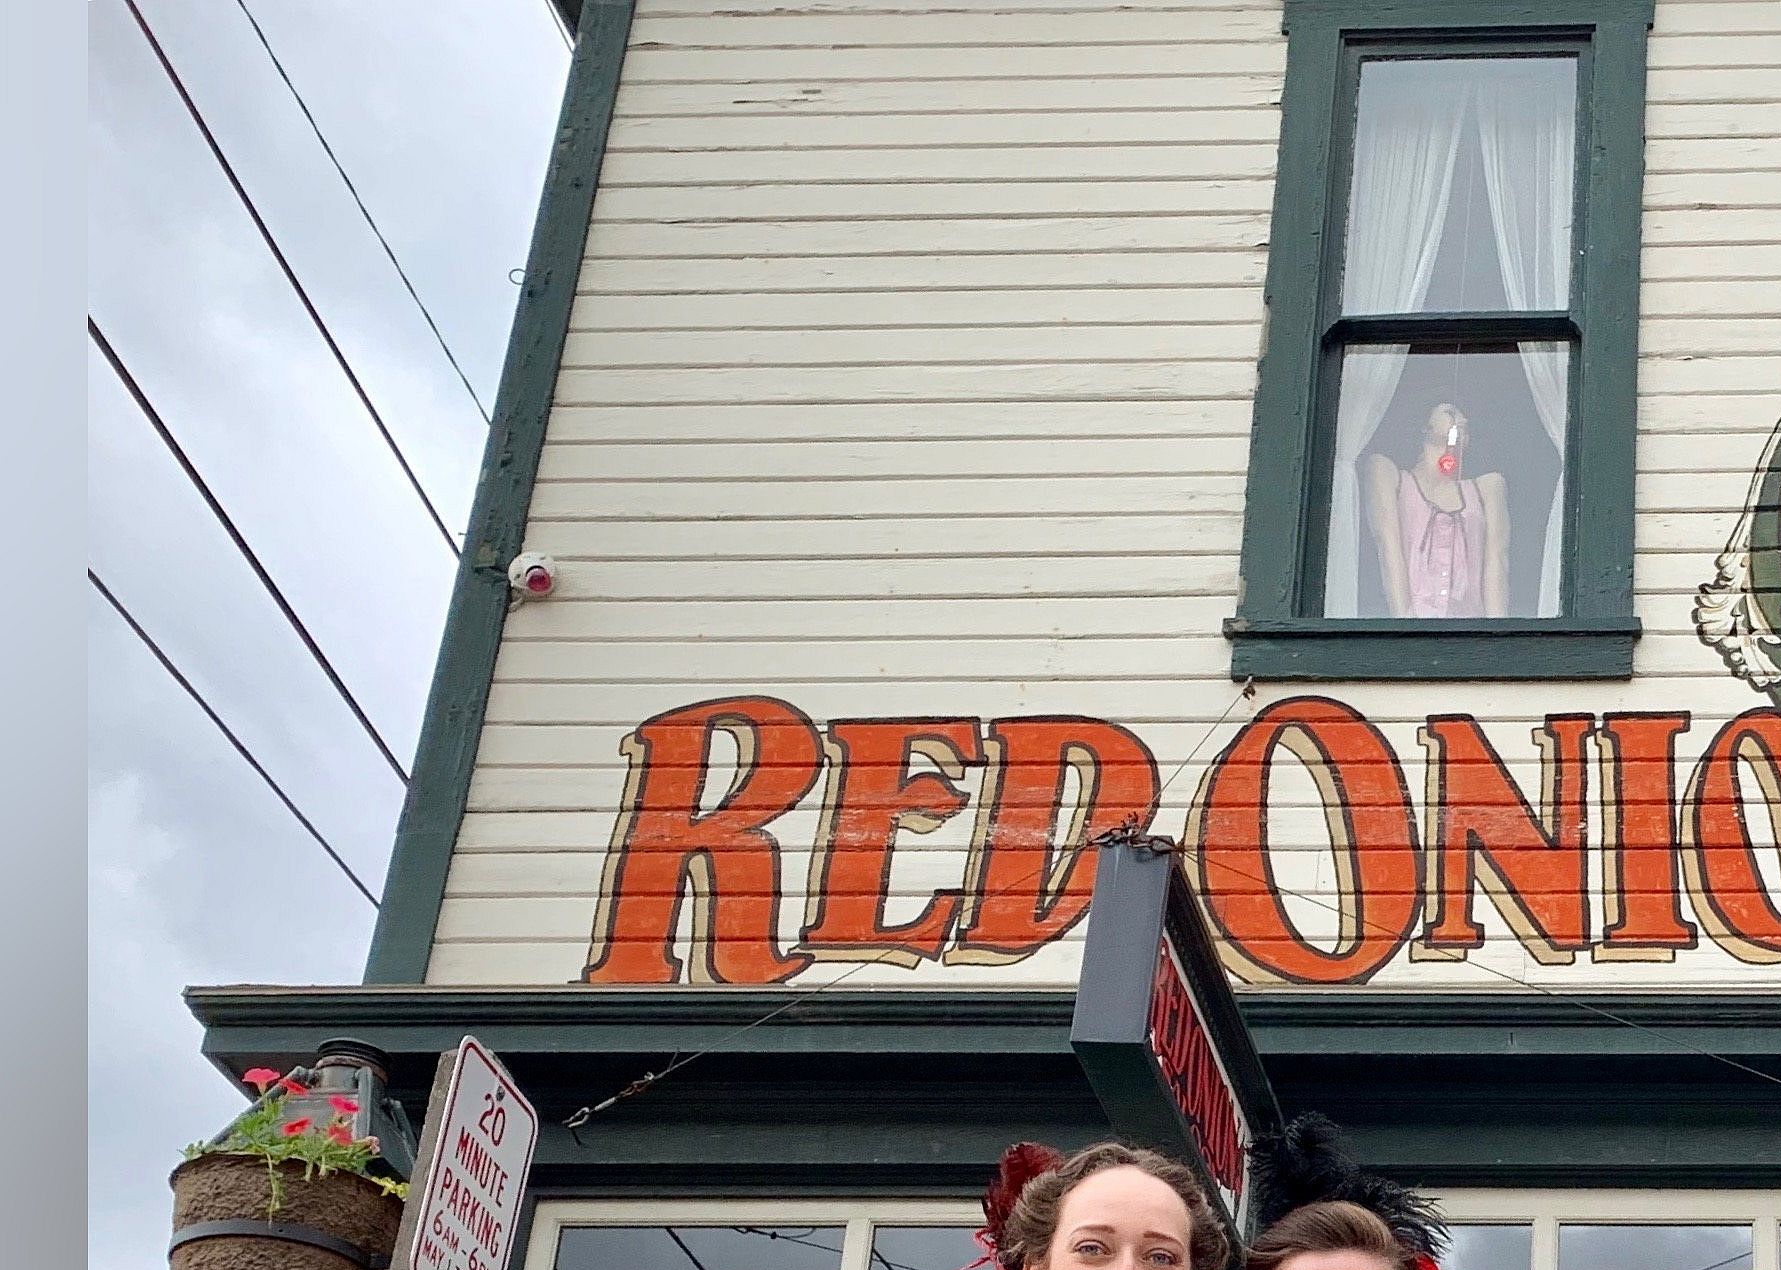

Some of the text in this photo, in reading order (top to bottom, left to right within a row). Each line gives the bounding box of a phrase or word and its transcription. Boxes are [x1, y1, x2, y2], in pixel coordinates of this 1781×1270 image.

[582, 695, 1161, 985] RED
[478, 1092, 507, 1147] 20
[455, 1126, 509, 1208] MINUTE
[422, 1235, 445, 1270] MAY
[439, 1166, 503, 1259] PARKING
